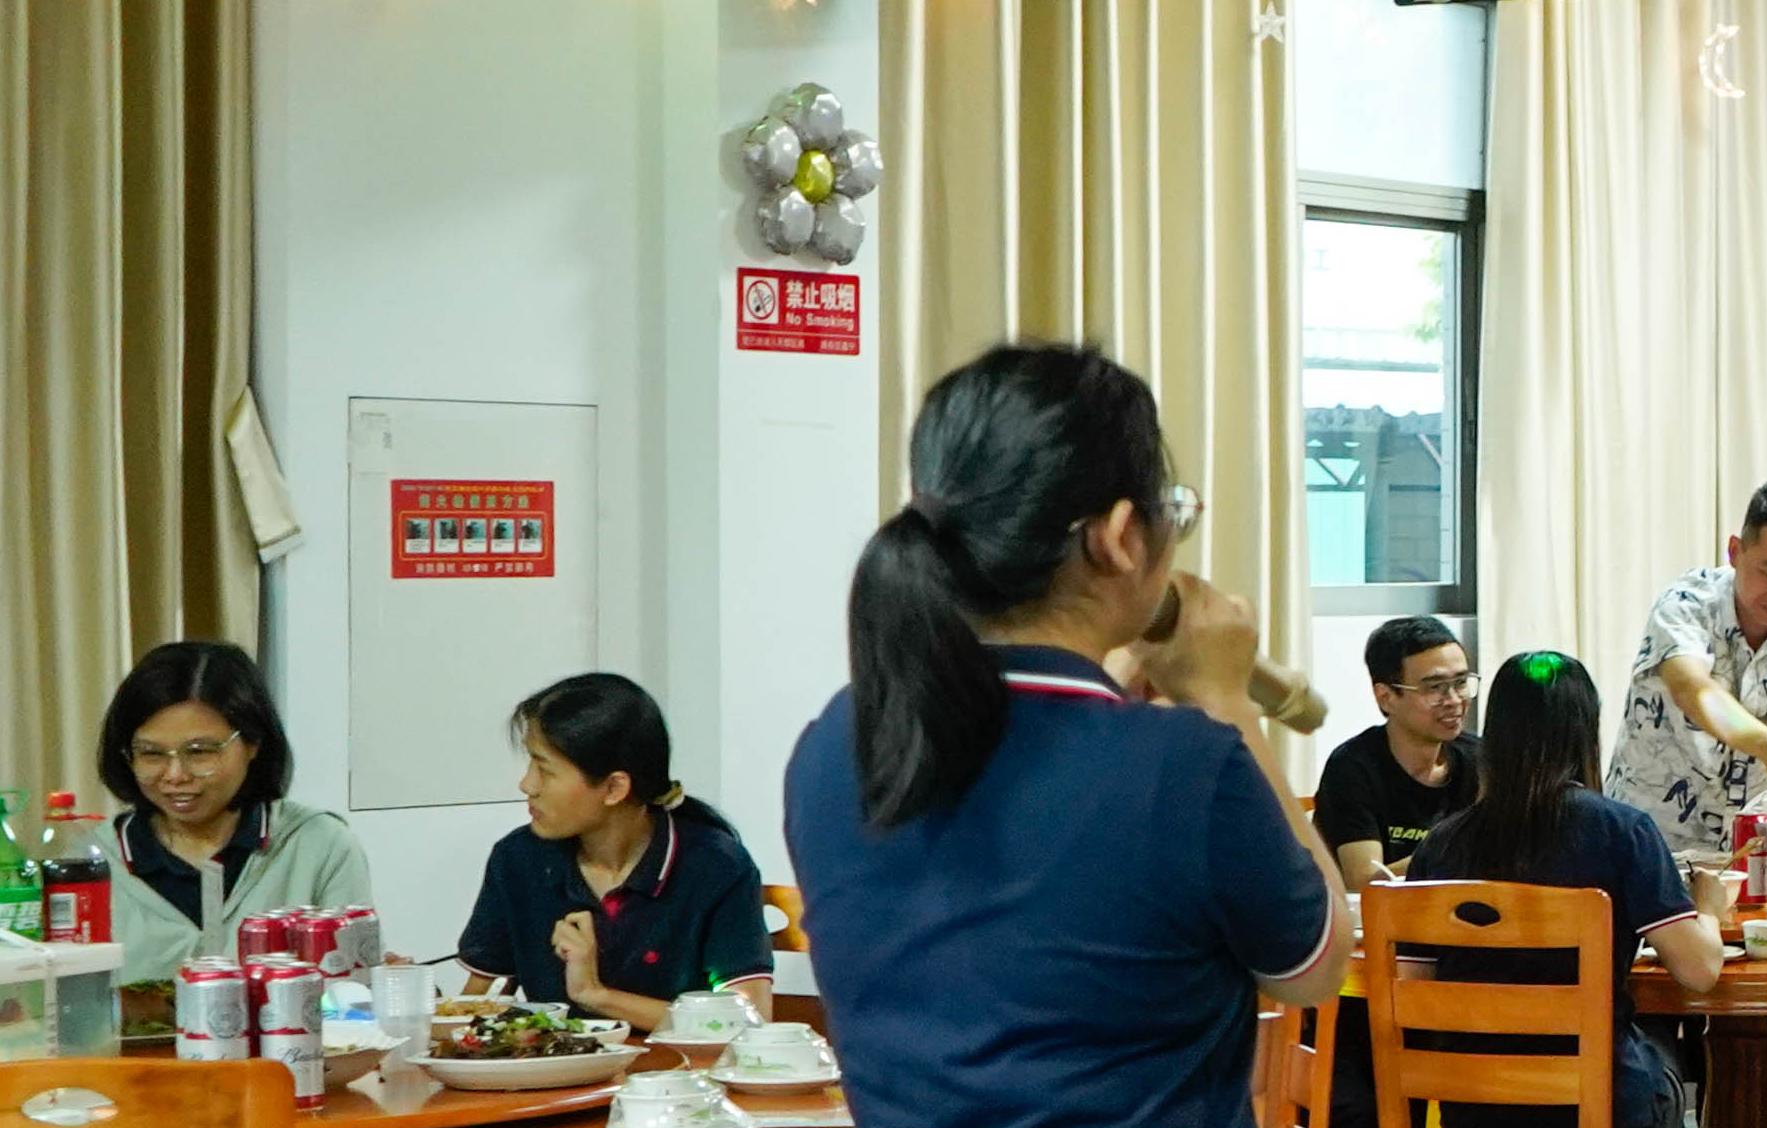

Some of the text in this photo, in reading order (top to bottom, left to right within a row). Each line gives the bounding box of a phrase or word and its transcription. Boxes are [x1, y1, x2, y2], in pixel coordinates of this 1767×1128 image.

[785, 279, 856, 312] 禁止吸烟
[784, 312, 854, 332] No Smoking
